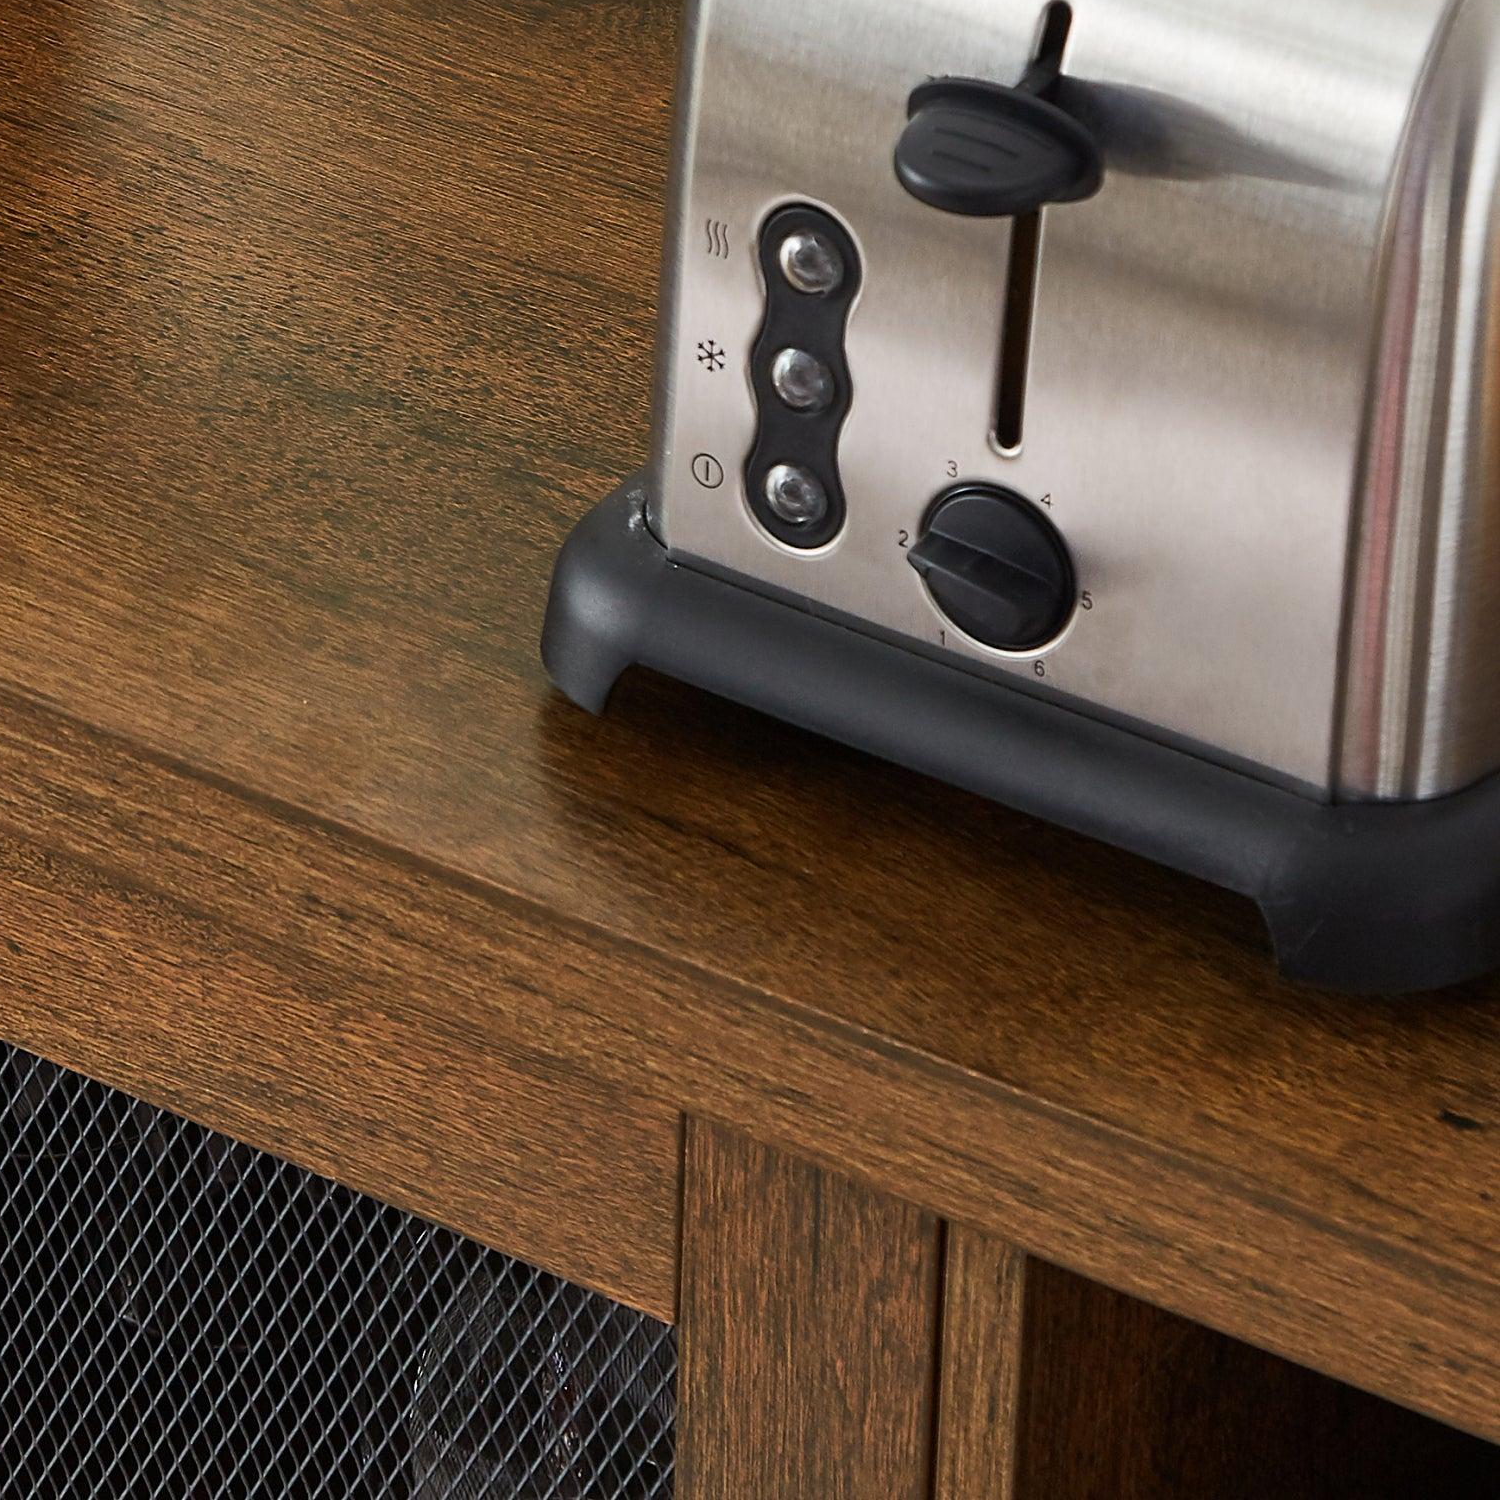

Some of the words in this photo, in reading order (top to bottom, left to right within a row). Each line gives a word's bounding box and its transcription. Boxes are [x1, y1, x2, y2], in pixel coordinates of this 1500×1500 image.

[946, 460, 958, 478] 3
[1040, 493, 1054, 509] 4
[898, 529, 909, 548] 2
[1081, 590, 1093, 611] 5
[939, 630, 946, 646] 1
[1033, 659, 1046, 677] 6
